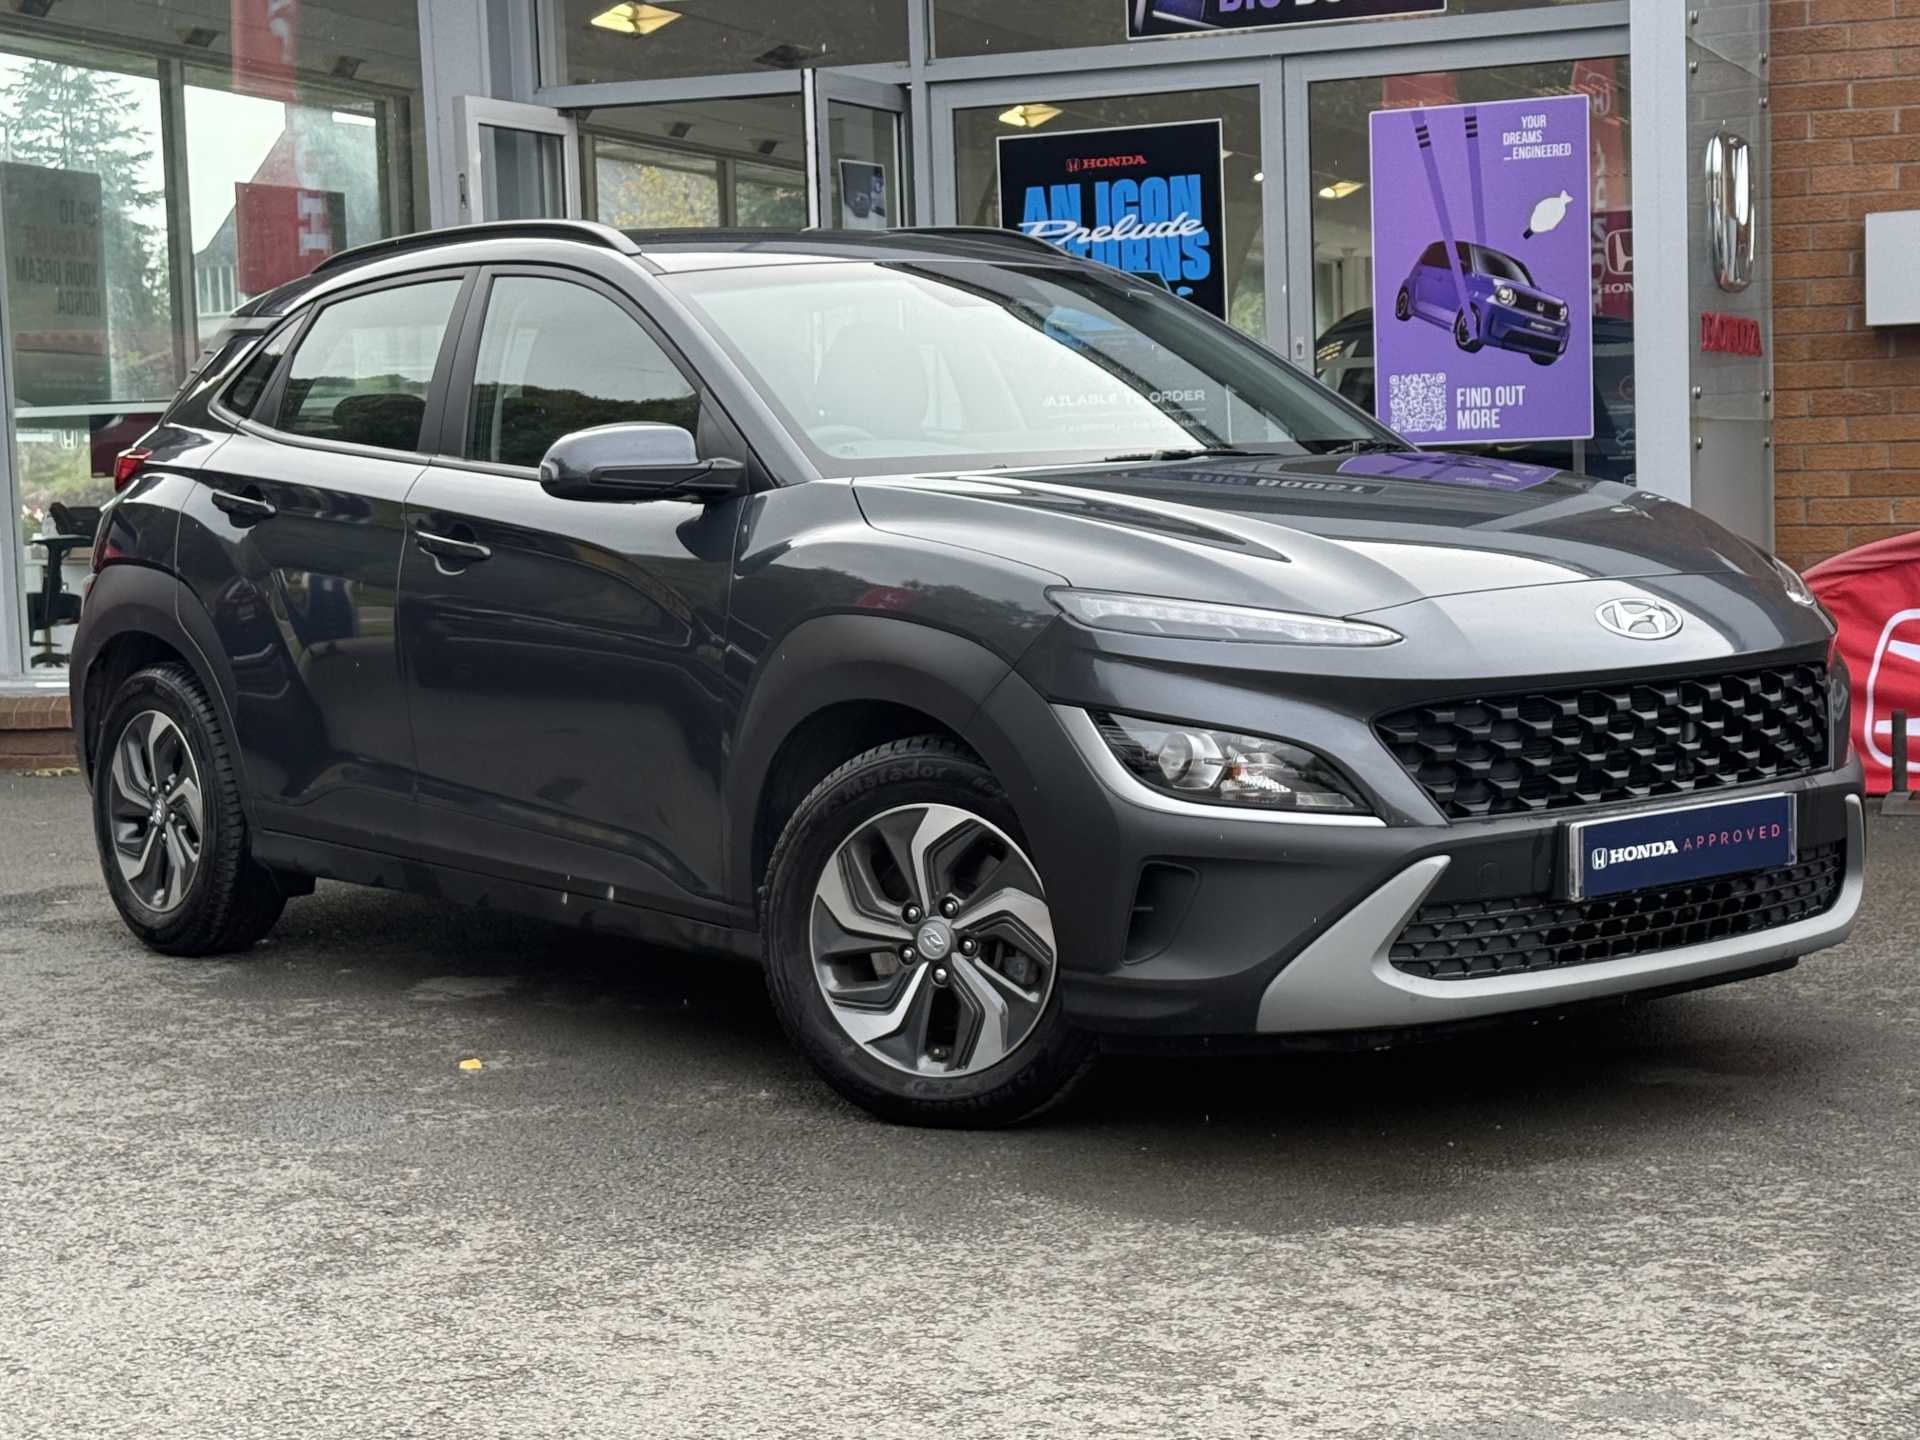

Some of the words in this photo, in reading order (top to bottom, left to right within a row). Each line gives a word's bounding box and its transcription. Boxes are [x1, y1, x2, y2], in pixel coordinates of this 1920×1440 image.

[1521, 114, 1547, 129] YOUR
[1503, 130, 1543, 146] DREAMS
[1083, 155, 1147, 170] HONDA
[1018, 211, 1205, 246] Prelude
[1149, 389, 1206, 403] ORDER
[1456, 387, 1492, 408] FIND
[1495, 384, 1526, 407] OUT
[1456, 407, 1501, 430] MORE
[1609, 840, 1679, 864] HONDA
[1683, 823, 1781, 851] APPROVED
